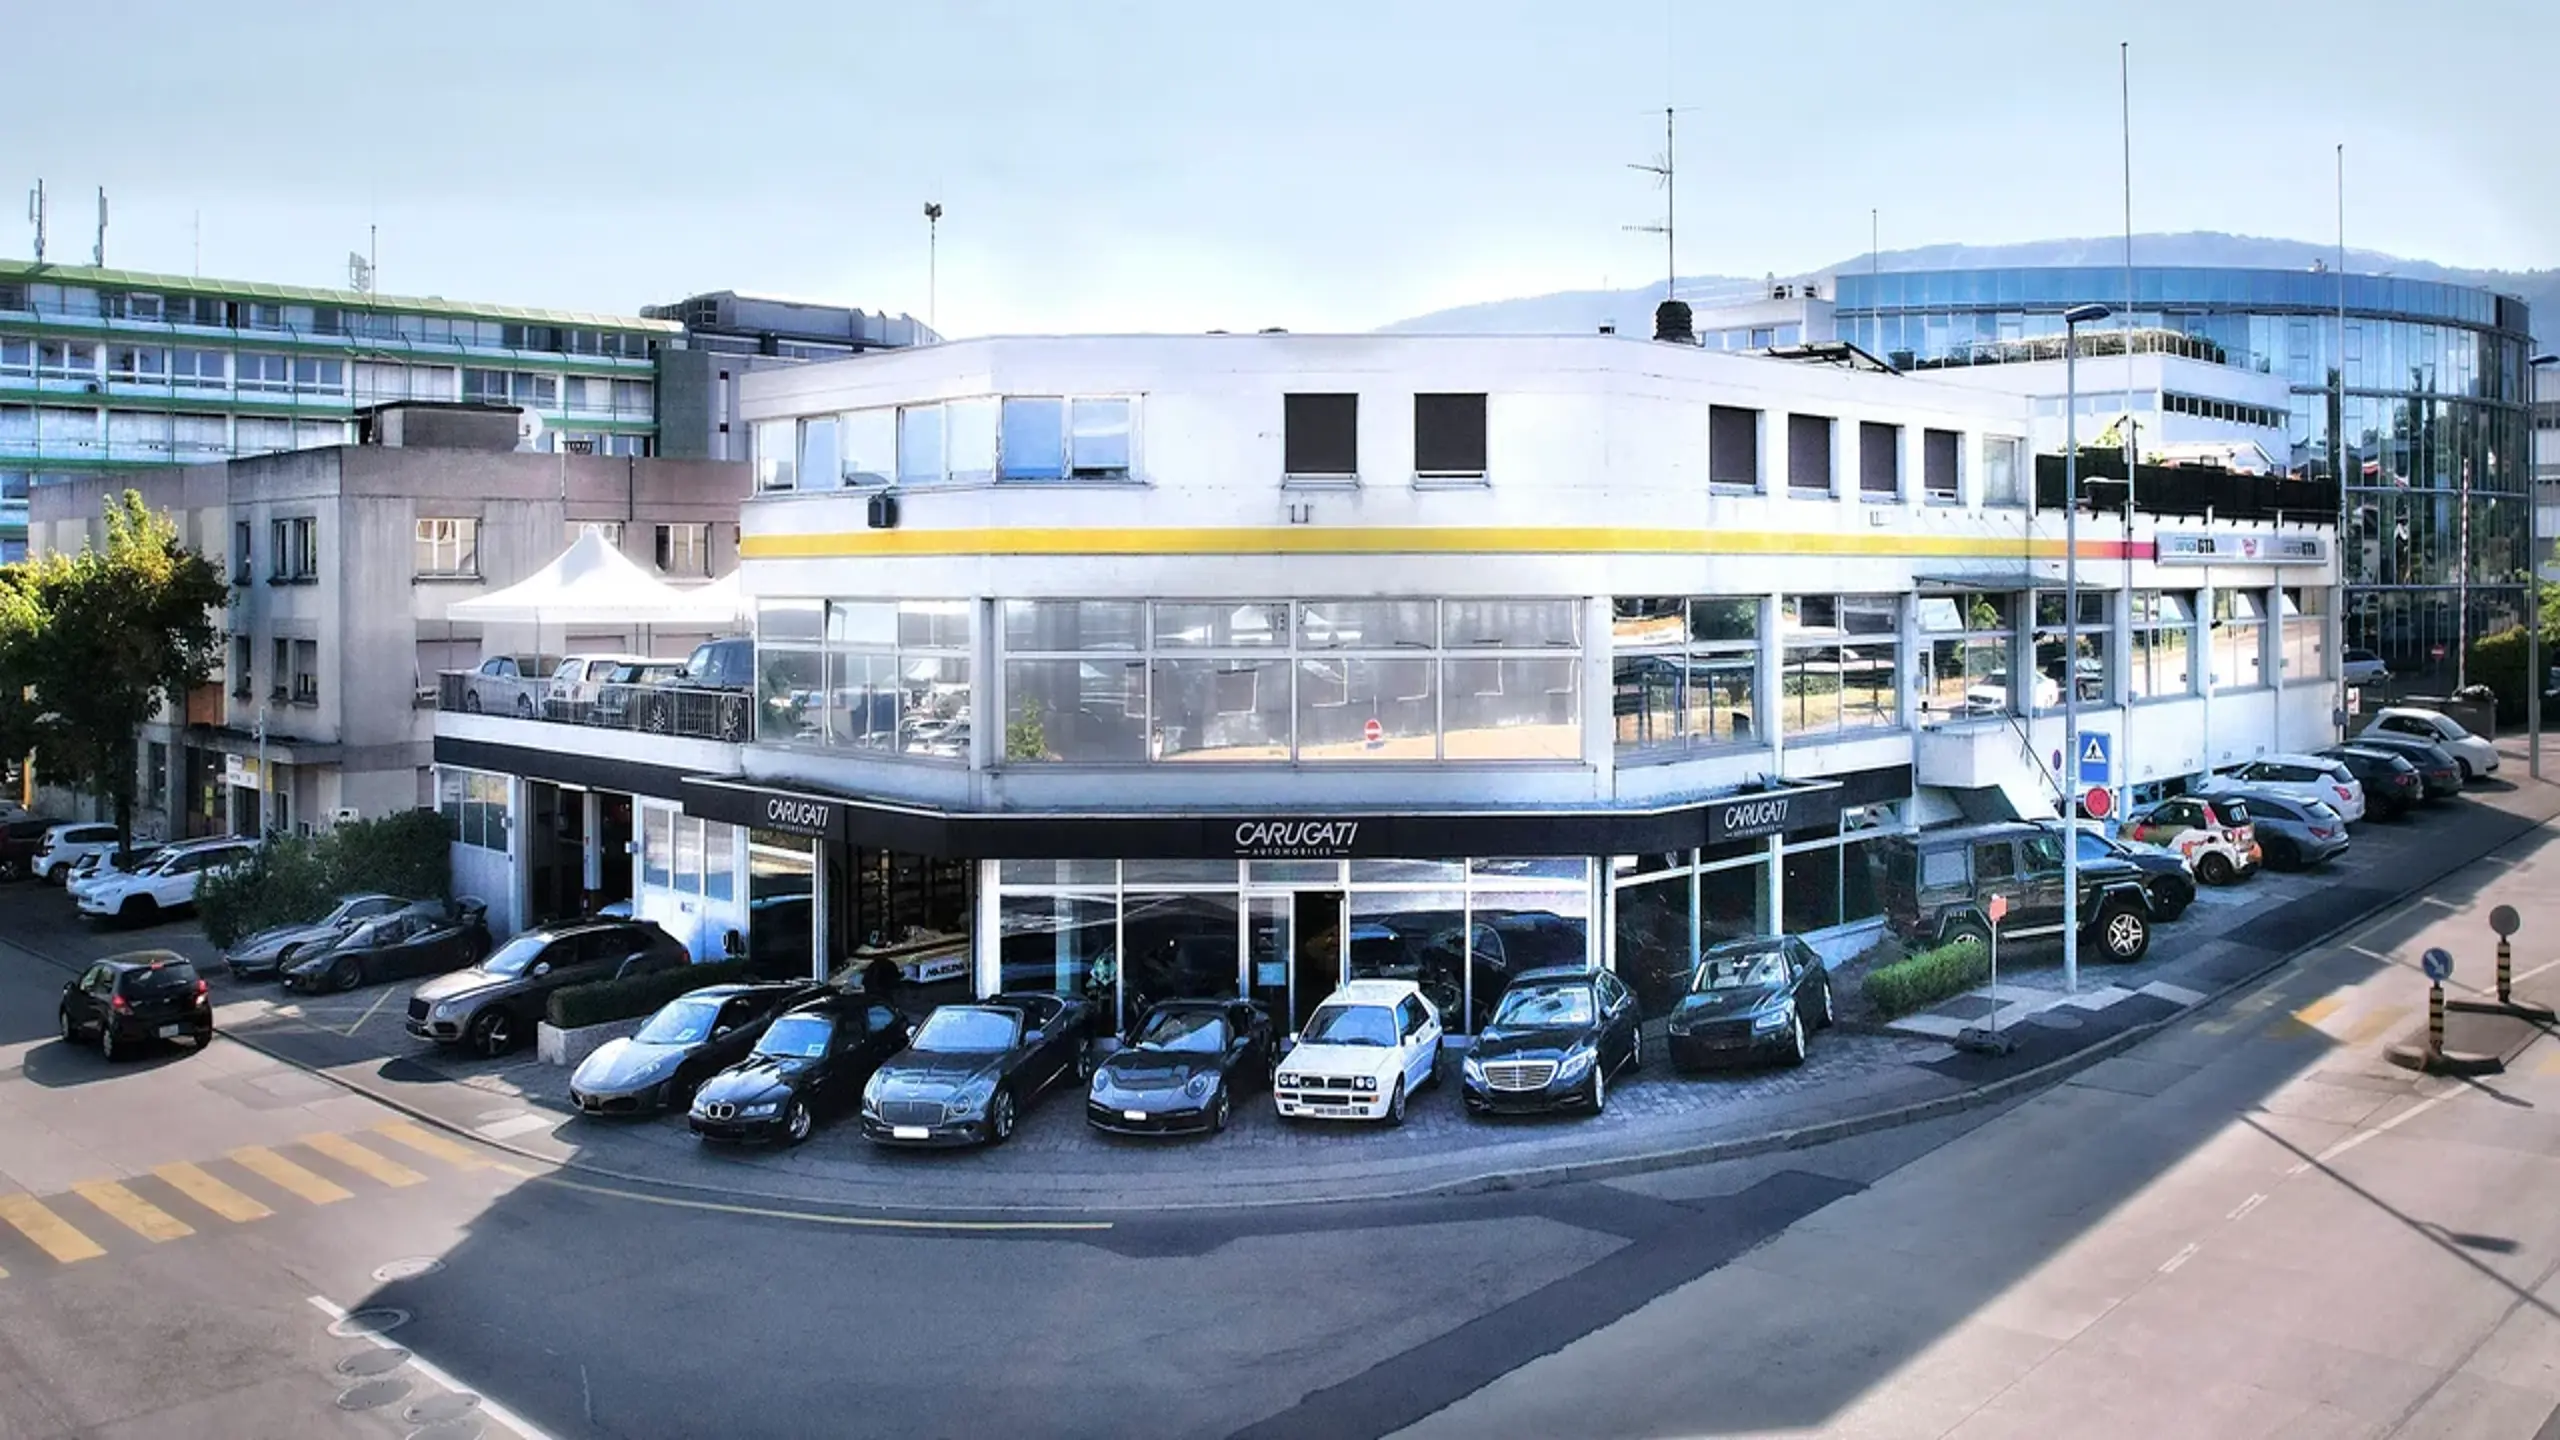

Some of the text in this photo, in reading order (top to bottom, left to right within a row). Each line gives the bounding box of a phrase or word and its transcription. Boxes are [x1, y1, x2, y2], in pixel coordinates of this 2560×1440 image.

[767, 798, 830, 828] CARUGATI
[1725, 799, 1789, 829] CARUGATI
[1235, 821, 1359, 846] CARUGATI
